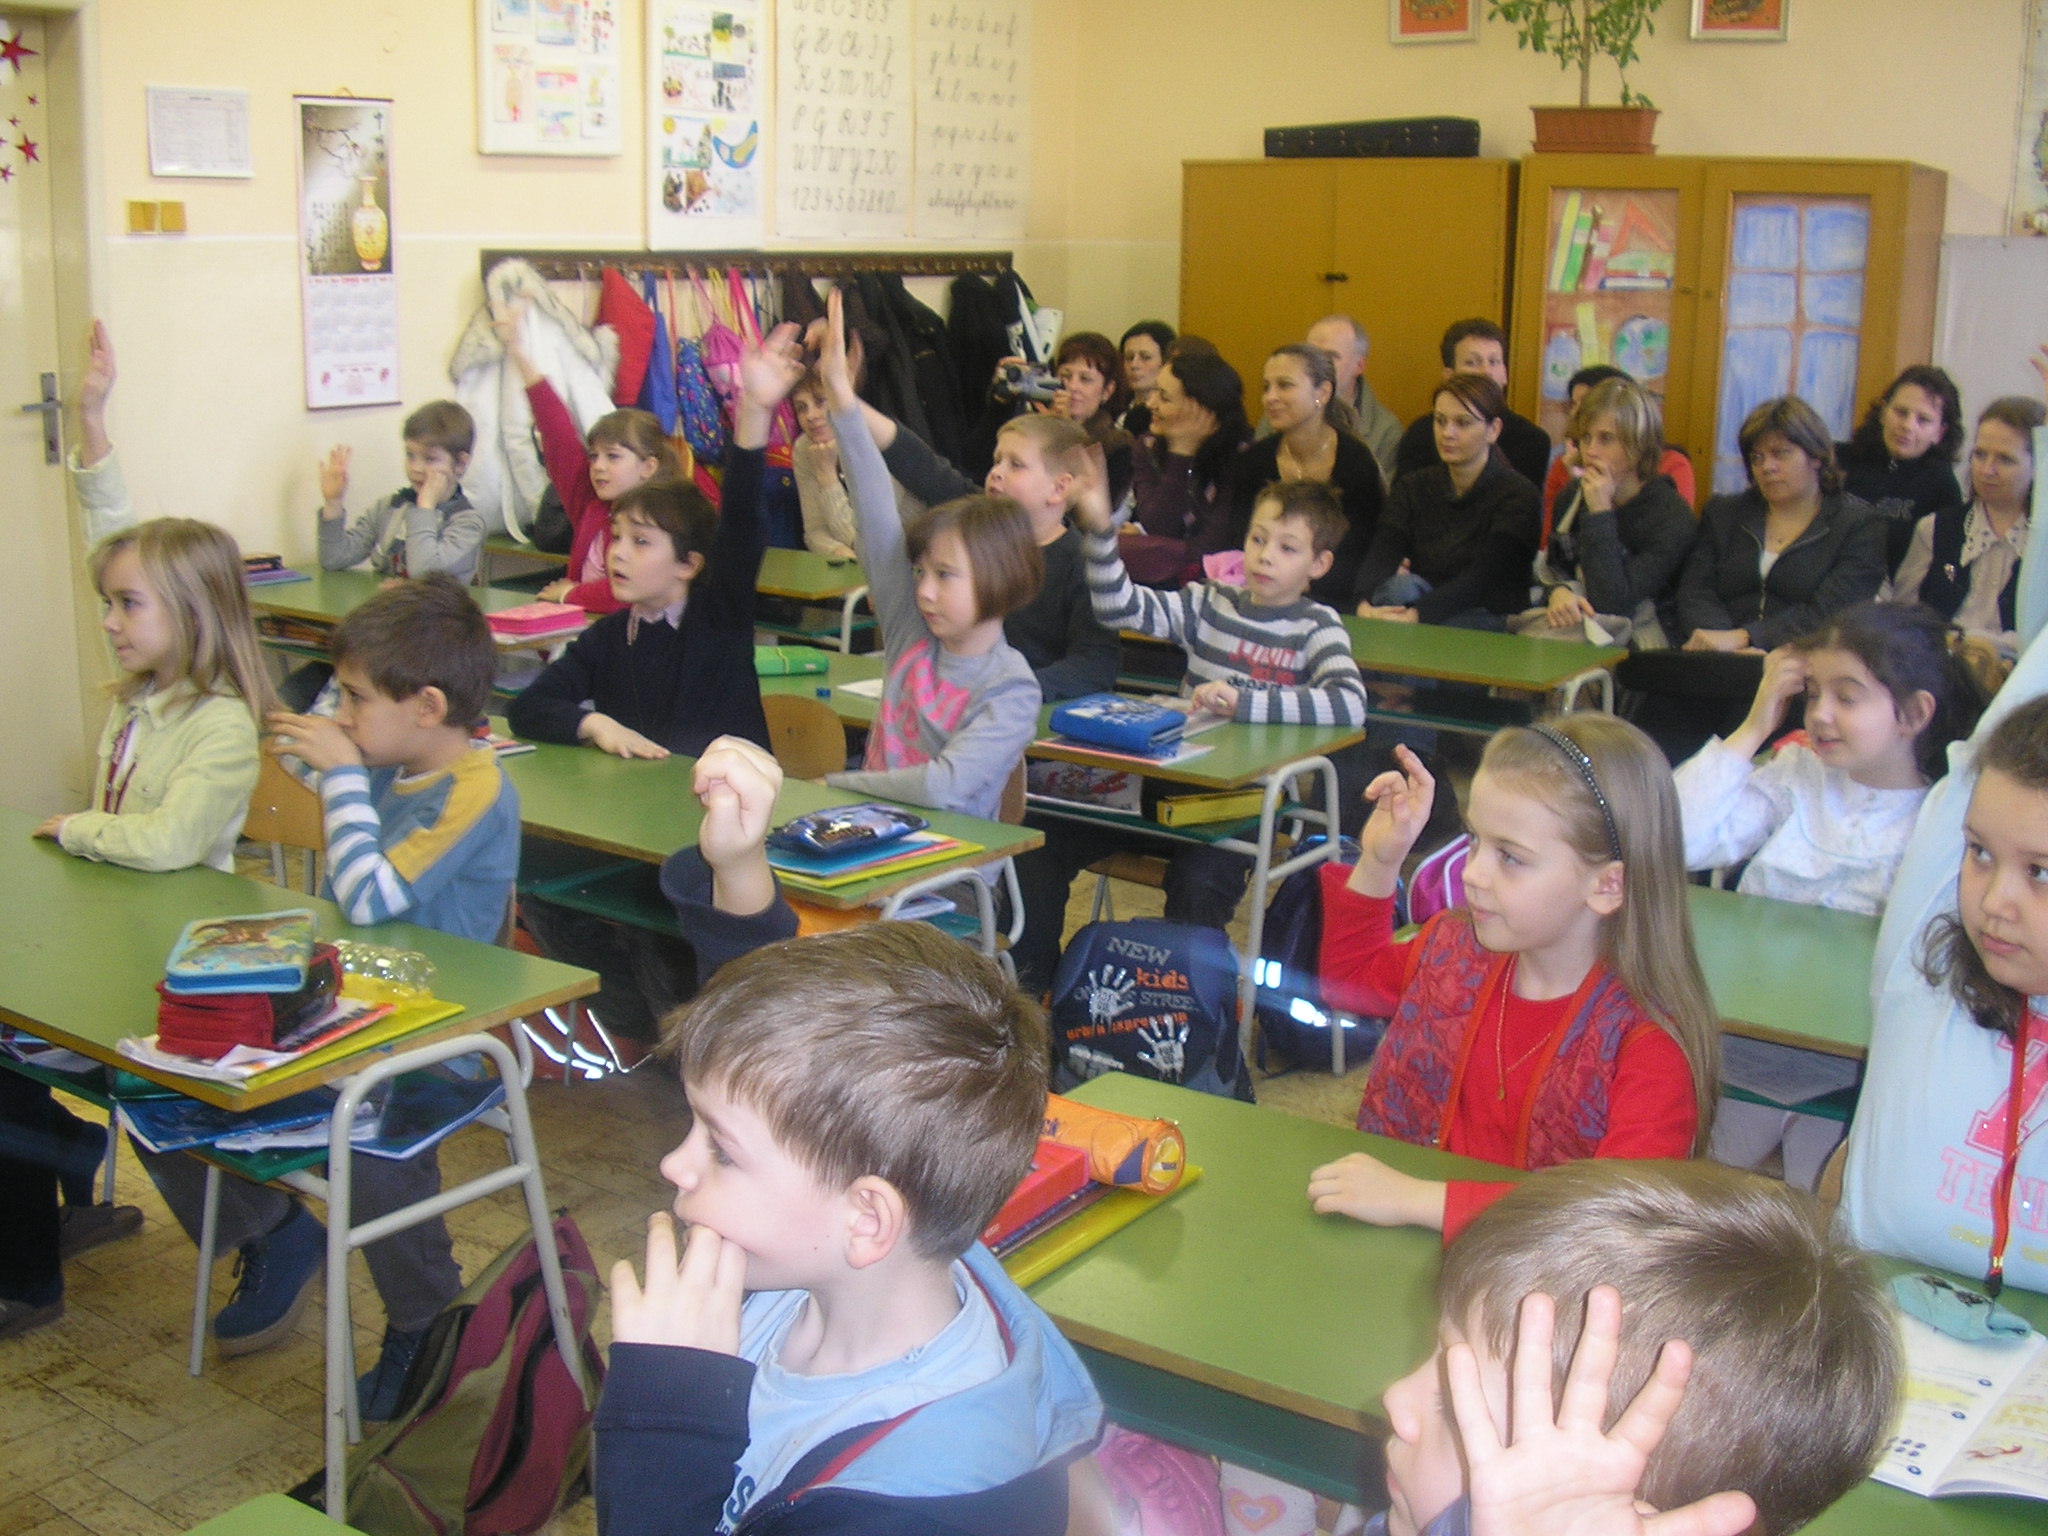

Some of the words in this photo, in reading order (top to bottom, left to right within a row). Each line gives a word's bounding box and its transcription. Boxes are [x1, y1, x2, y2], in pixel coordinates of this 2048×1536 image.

[1107, 936, 1171, 967] NEW
[1135, 967, 1190, 992] kids
[1139, 990, 1201, 1012] STREE
